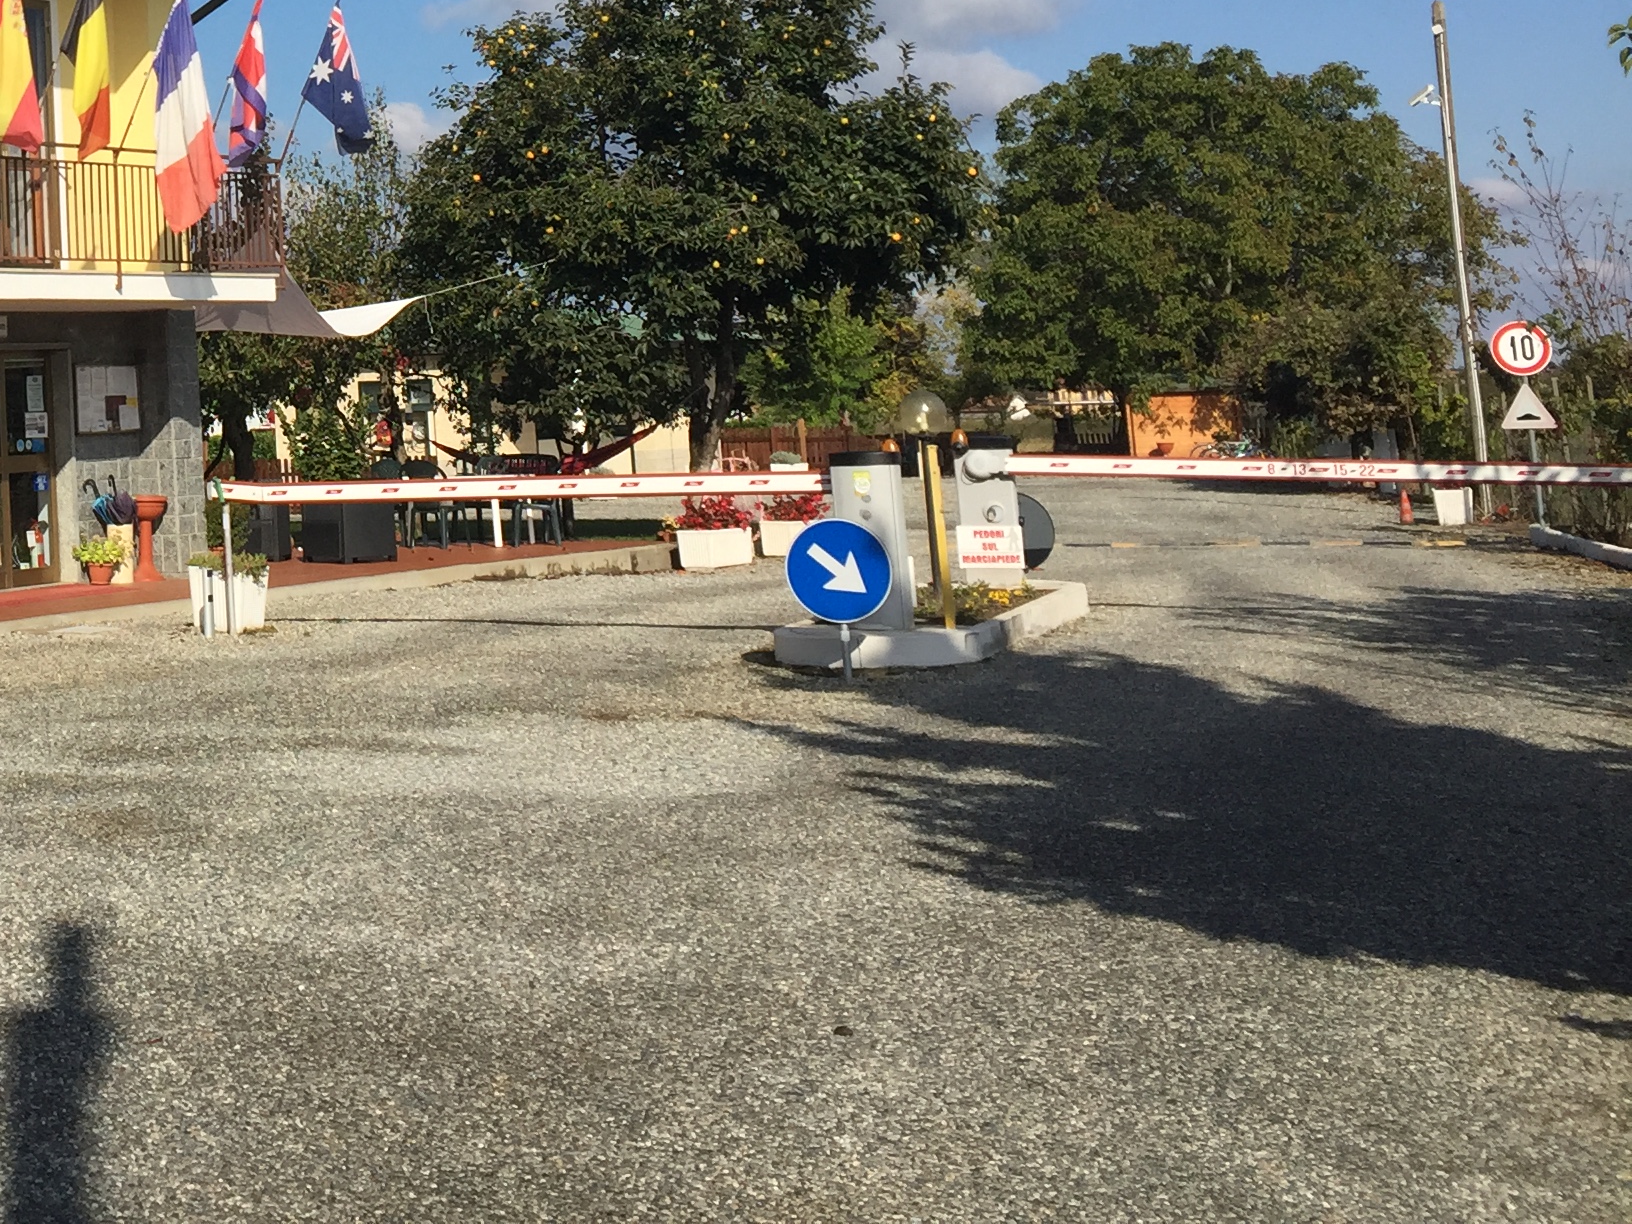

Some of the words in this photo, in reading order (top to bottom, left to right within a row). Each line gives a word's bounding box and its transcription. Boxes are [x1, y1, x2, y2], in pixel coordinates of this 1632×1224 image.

[1510, 335, 1535, 361] 10
[982, 542, 999, 551] SUL
[962, 555, 1021, 564] MARCIAPIEDE
